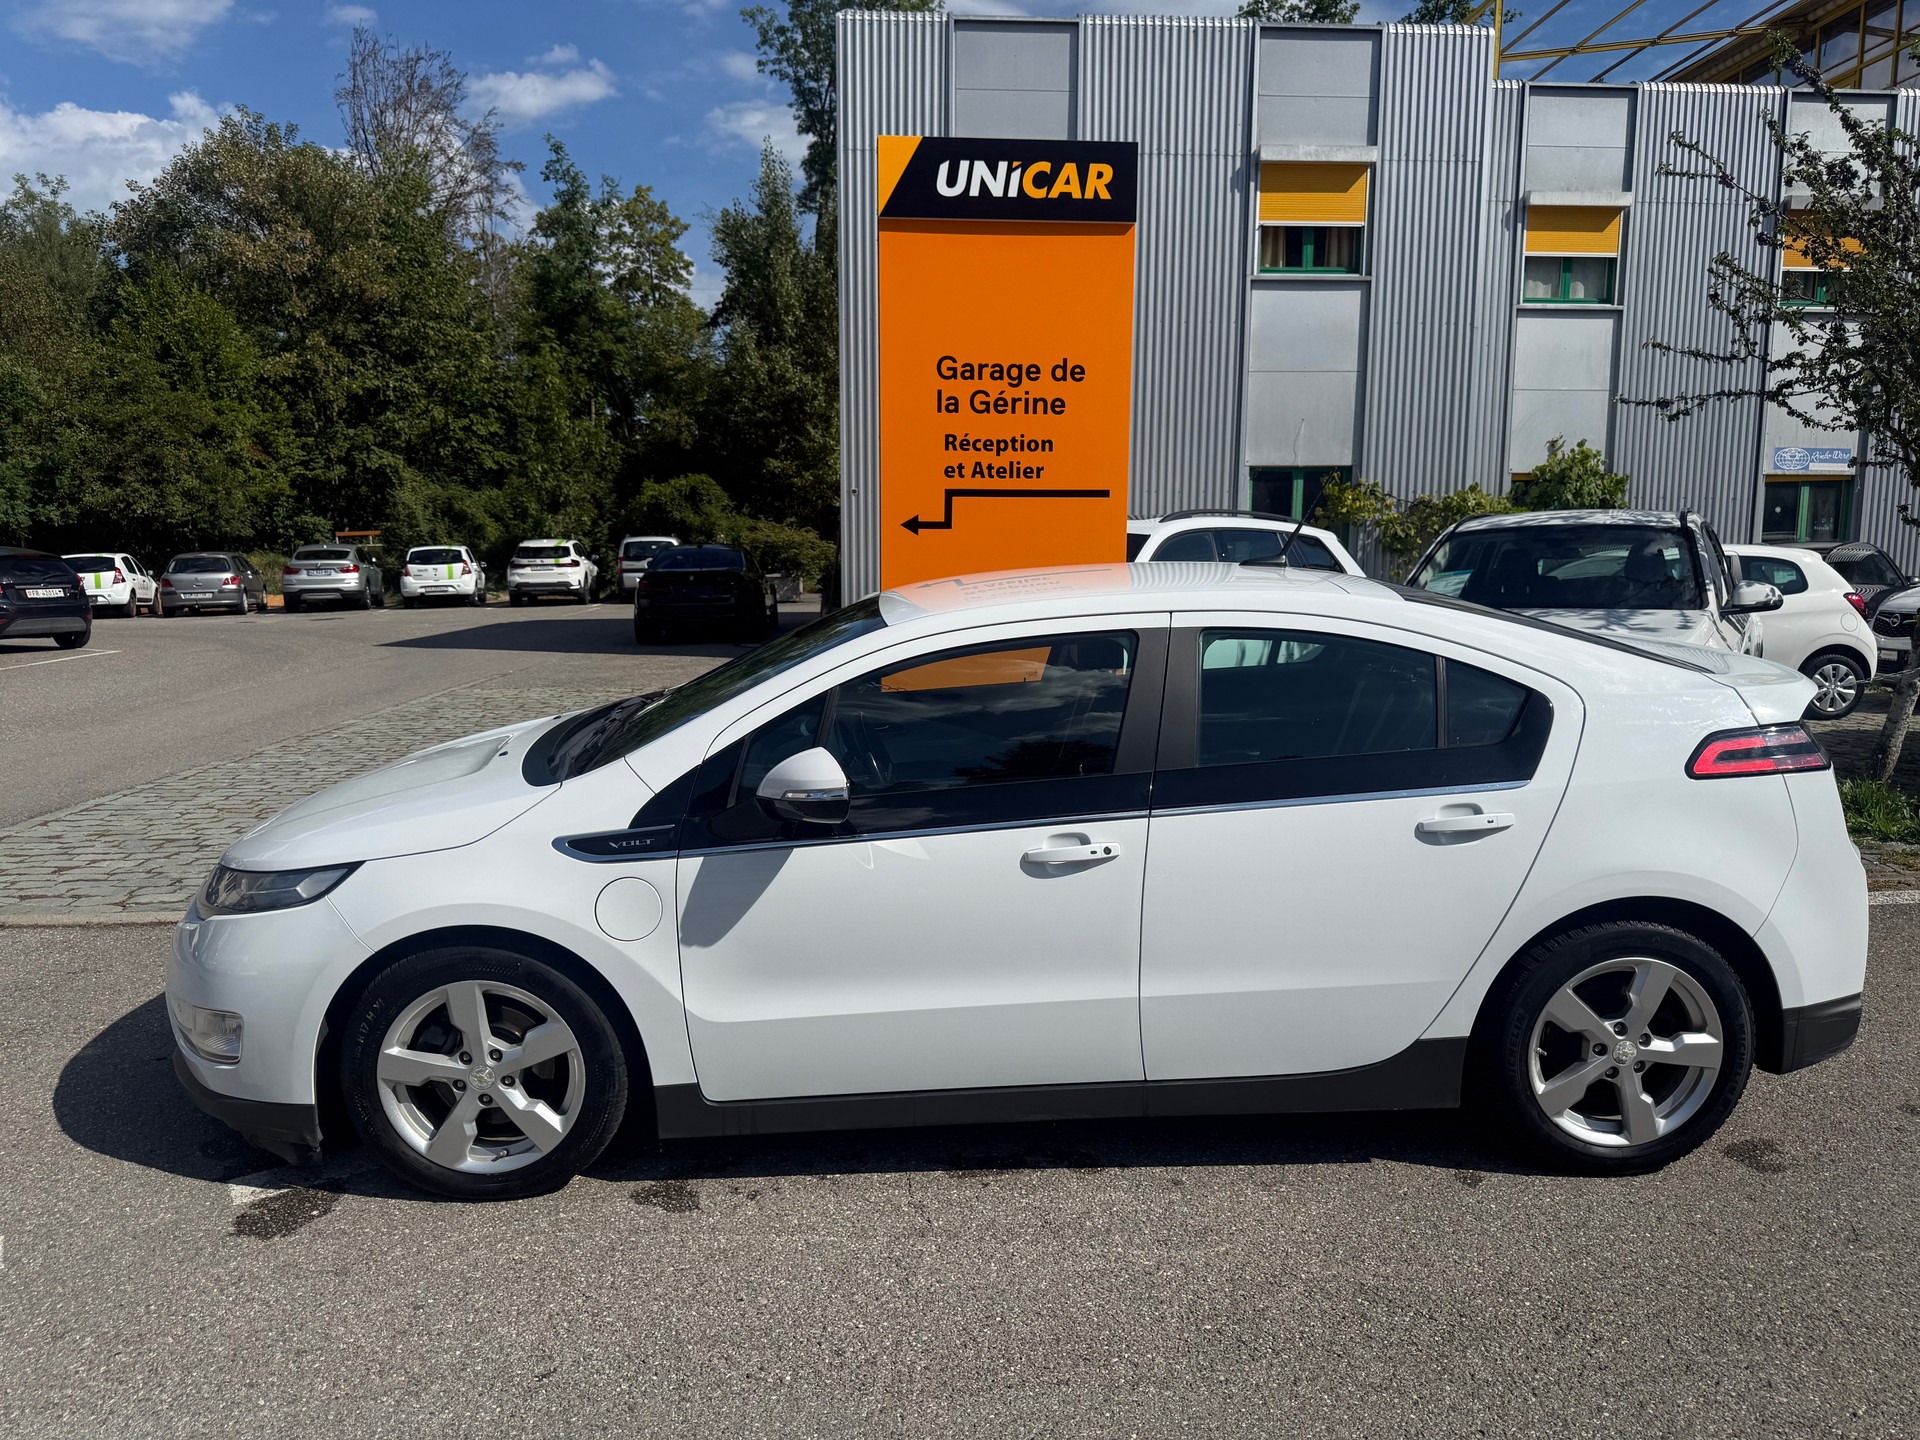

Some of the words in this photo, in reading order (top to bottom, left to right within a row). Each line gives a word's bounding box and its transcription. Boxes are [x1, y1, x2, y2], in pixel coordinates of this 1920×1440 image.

[936, 355, 1042, 388] Garage
[1050, 358, 1087, 383] de
[936, 389, 961, 415] la
[969, 389, 1067, 416] Gérine
[943, 433, 1055, 457] Réception
[943, 462, 966, 480] et
[970, 460, 1046, 480] Atelier
[608, 838, 656, 849] VOLT
[1506, 1011, 1528, 1089] MICHELIN
